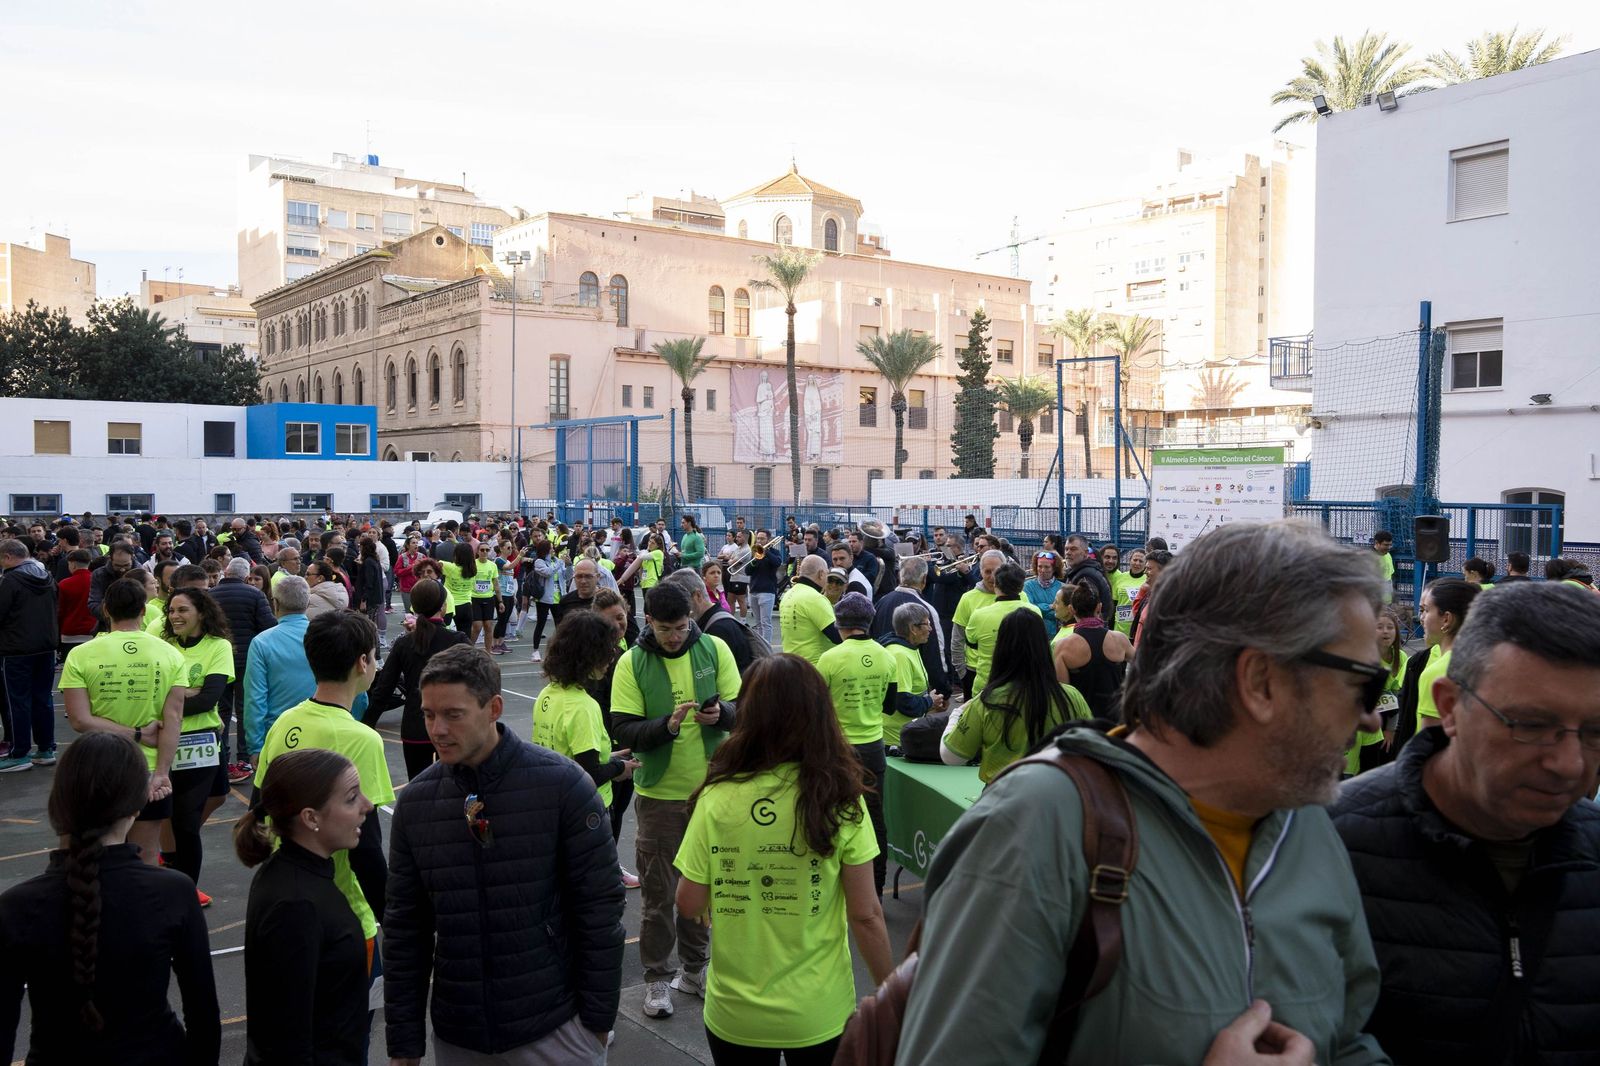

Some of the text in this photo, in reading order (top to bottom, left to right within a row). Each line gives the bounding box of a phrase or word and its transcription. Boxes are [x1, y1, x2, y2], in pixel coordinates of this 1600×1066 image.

[1166, 456, 1189, 464] Almería
[175, 745, 215, 761] 1719
[725, 877, 751, 886] cajamar
